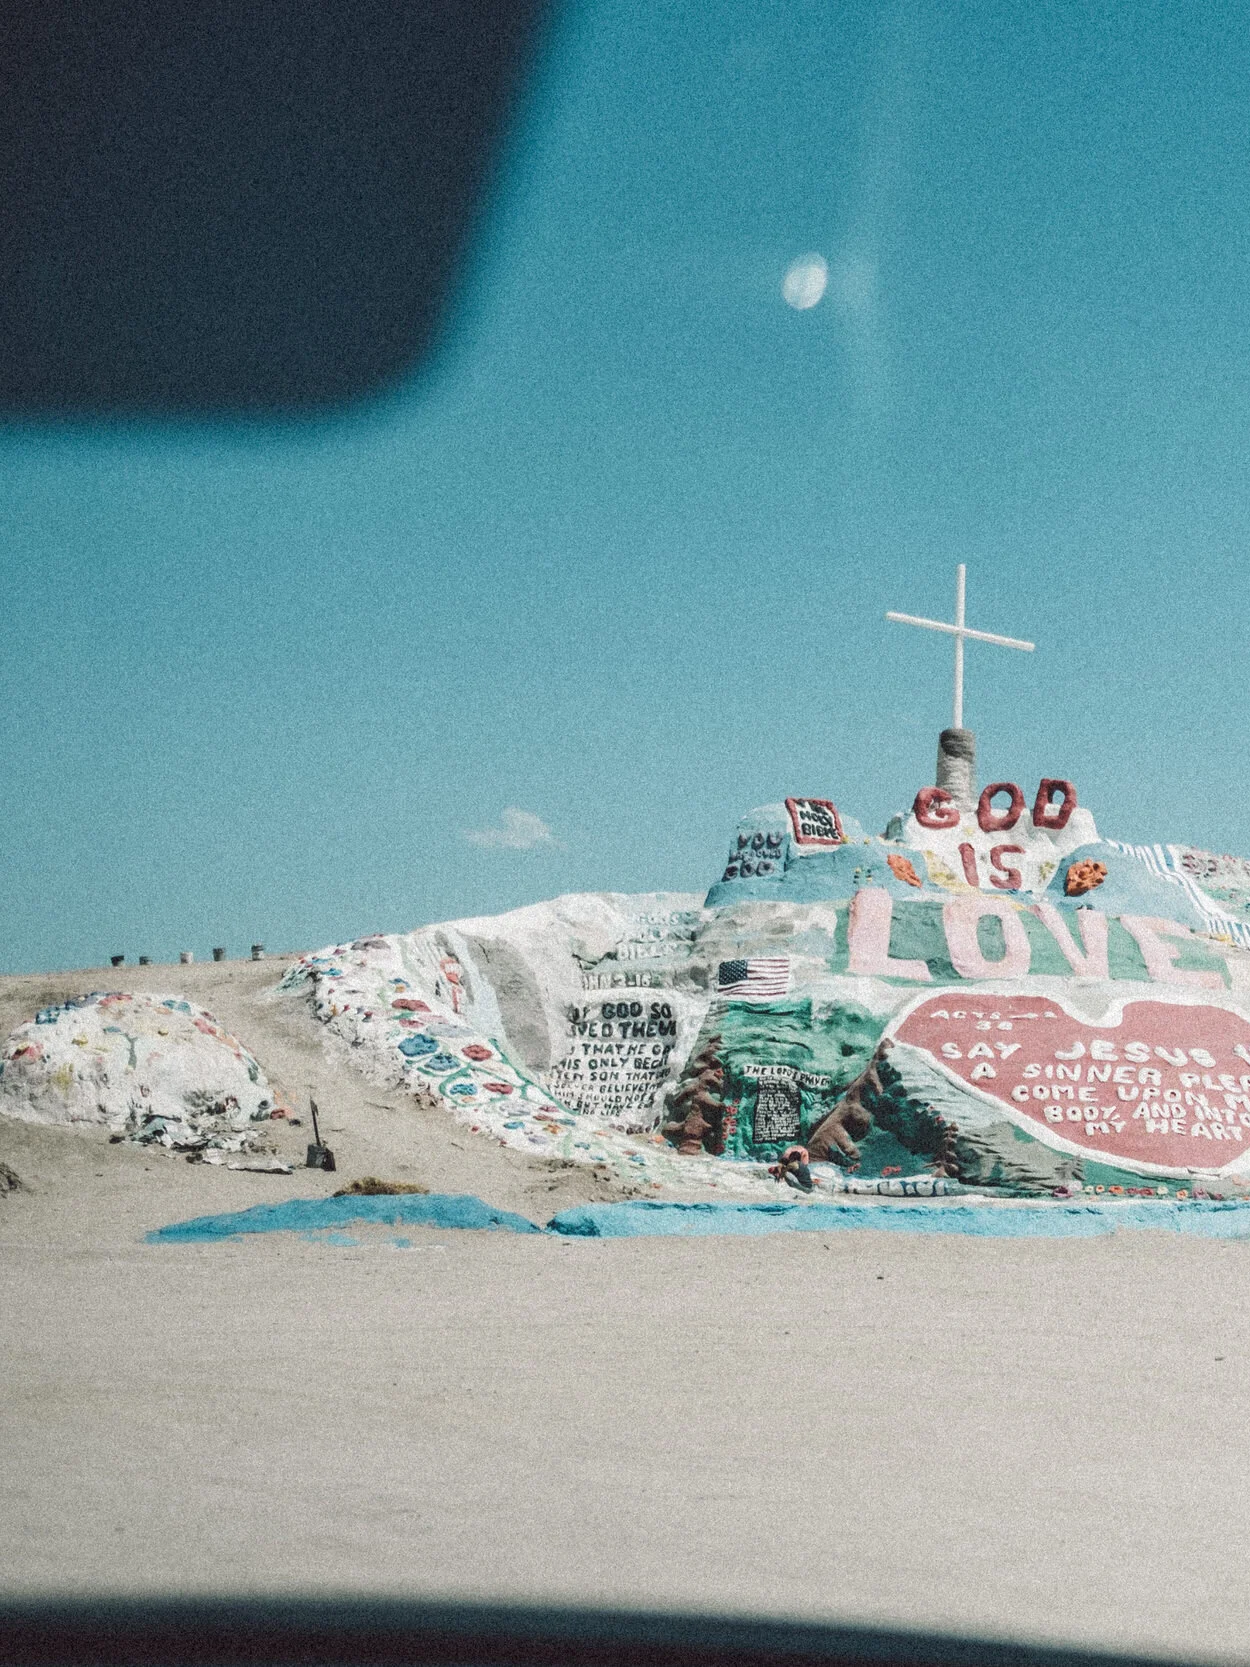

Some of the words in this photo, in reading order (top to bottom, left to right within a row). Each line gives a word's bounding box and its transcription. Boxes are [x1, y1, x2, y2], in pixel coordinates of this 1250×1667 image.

[914, 778, 1077, 832] GOD
[958, 842, 1025, 890] IS
[847, 887, 1230, 990] LOVE
[601, 1002, 643, 1020] GOD
[650, 1001, 673, 1020] SO
[582, 1042, 625, 1056] THAT
[941, 1041, 1022, 1060] SAY
[1055, 1039, 1216, 1068] JESUS
[588, 1057, 629, 1071] ONLY
[746, 1065, 767, 1076] THE
[970, 1062, 997, 1081] A
[1022, 1063, 1162, 1087] SINNER
[590, 1070, 620, 1082] SON
[626, 1070, 656, 1081] THAT
[1011, 1084, 1098, 1102] COME
[1117, 1085, 1209, 1107] UPON
[1132, 1101, 1187, 1119] AND
[1085, 1119, 1127, 1137] MY
[1145, 1118, 1243, 1142] HEART
